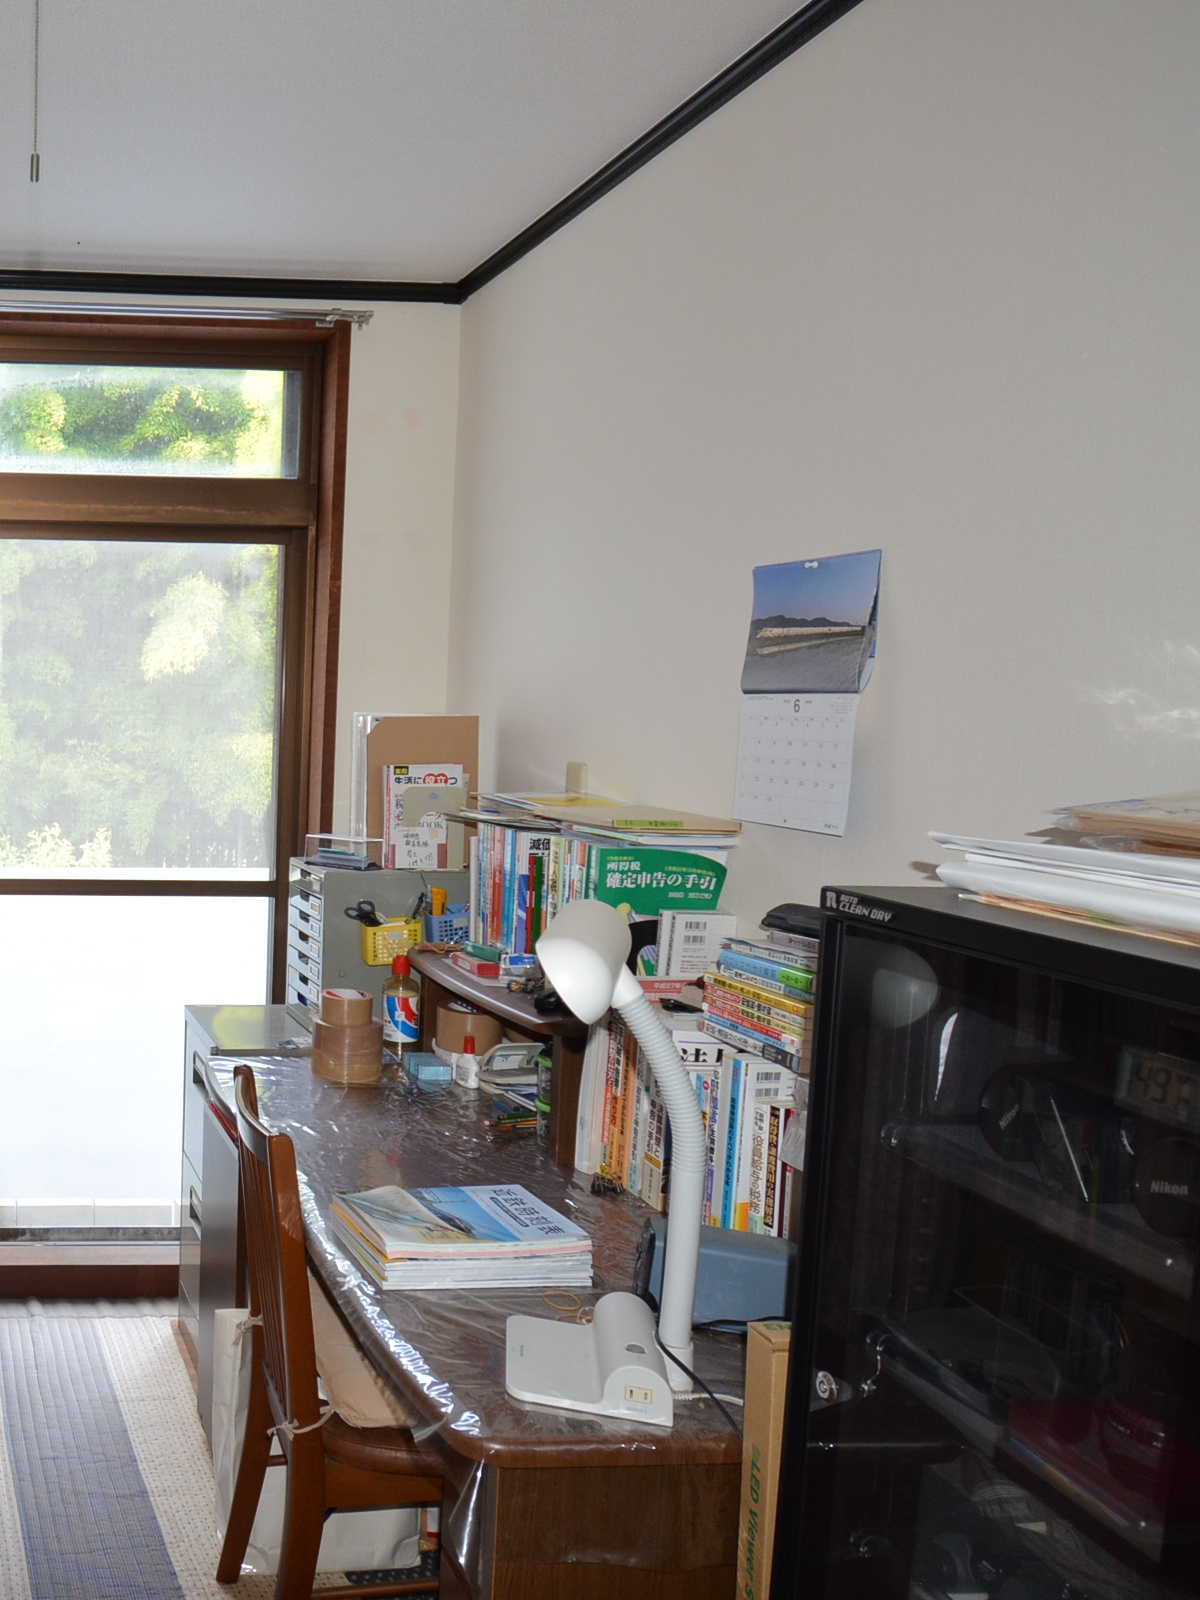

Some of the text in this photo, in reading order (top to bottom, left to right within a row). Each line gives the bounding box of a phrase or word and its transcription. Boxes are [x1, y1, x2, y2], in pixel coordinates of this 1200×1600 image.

[794, 698, 801, 713] 6
[394, 775, 458, 786] 生活に役立つ
[606, 861, 641, 871] 所得税
[606, 871, 718, 890] 確定申告の手引
[839, 902, 892, 923] CLEAN DRY
[999, 1103, 1020, 1131] Nikon
[1150, 1181, 1189, 1197] Nikon
[750, 1459, 761, 1505] LED
